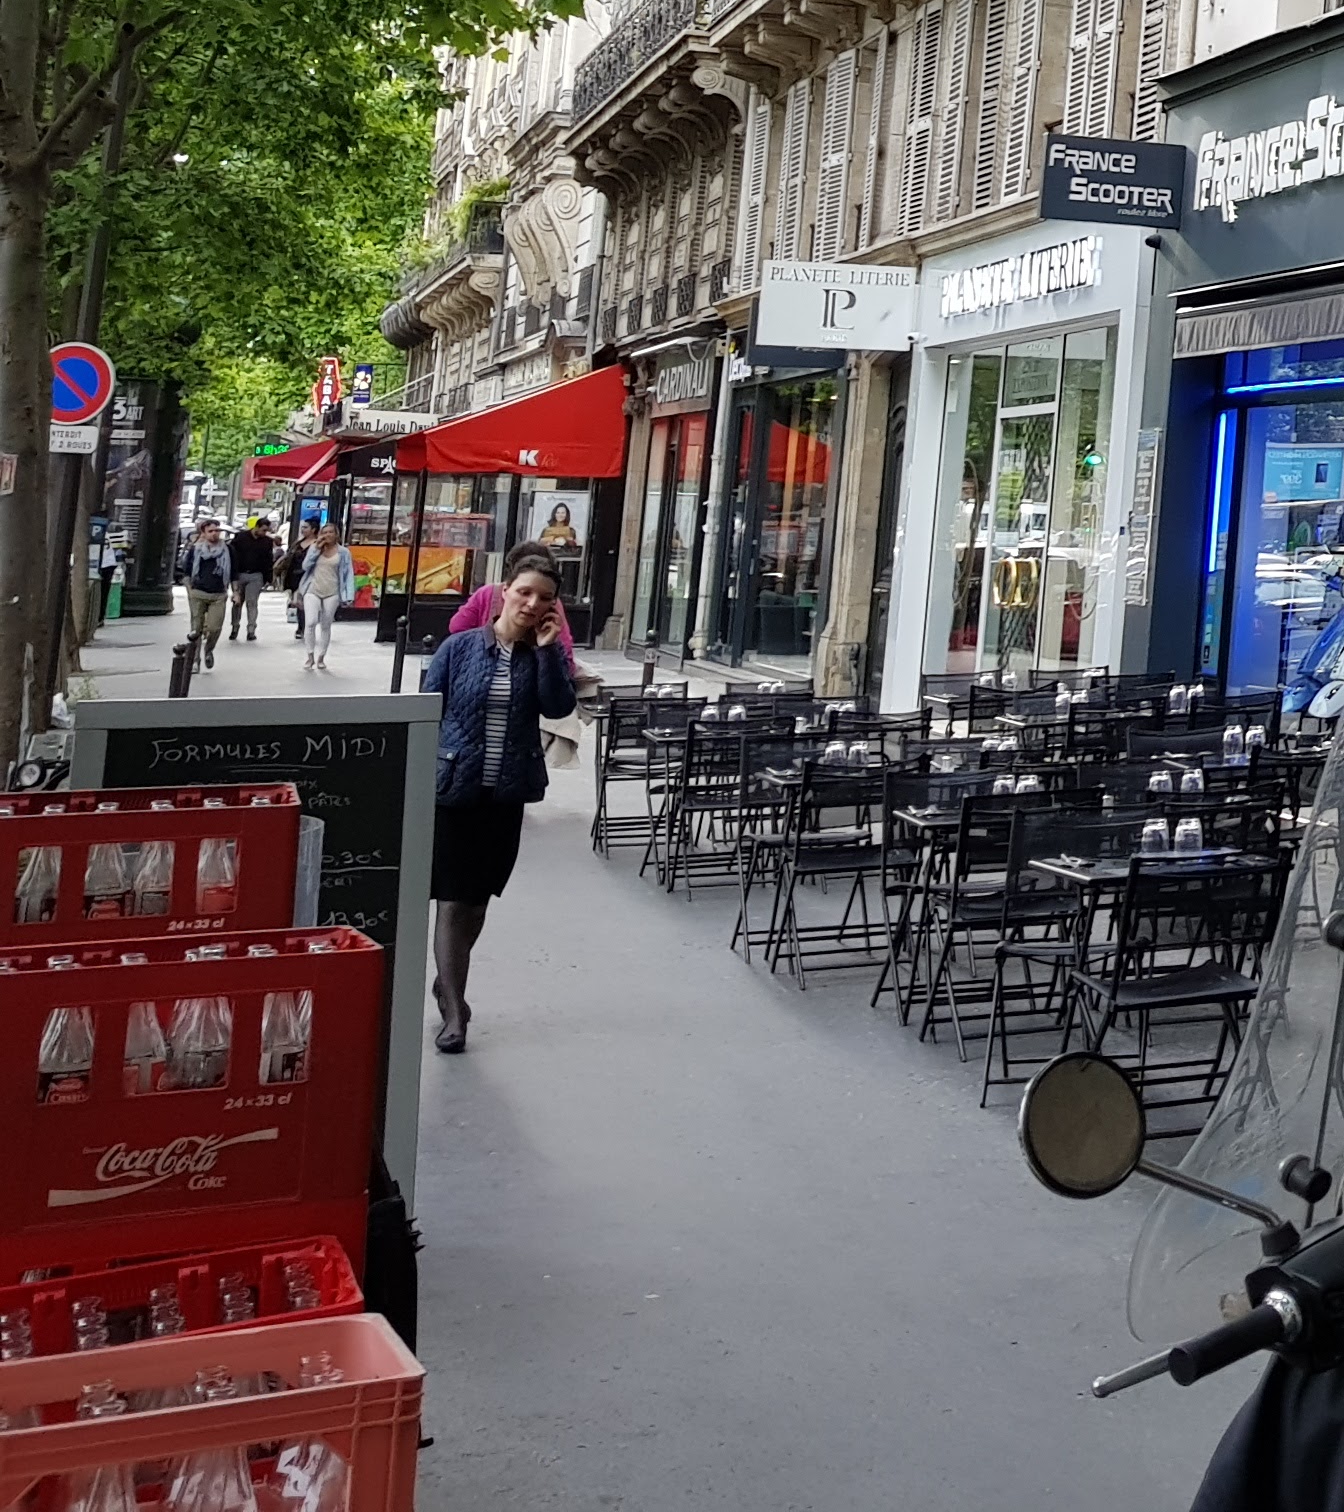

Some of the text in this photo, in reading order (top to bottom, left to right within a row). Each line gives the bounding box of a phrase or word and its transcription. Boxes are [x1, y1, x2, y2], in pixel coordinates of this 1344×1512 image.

[770, 266, 911, 287] PLANETE LITERIE
[376, 418, 406, 433] Louis
[149, 737, 282, 769] FORMULES
[95, 1132, 222, 1182] Coca-Cola
